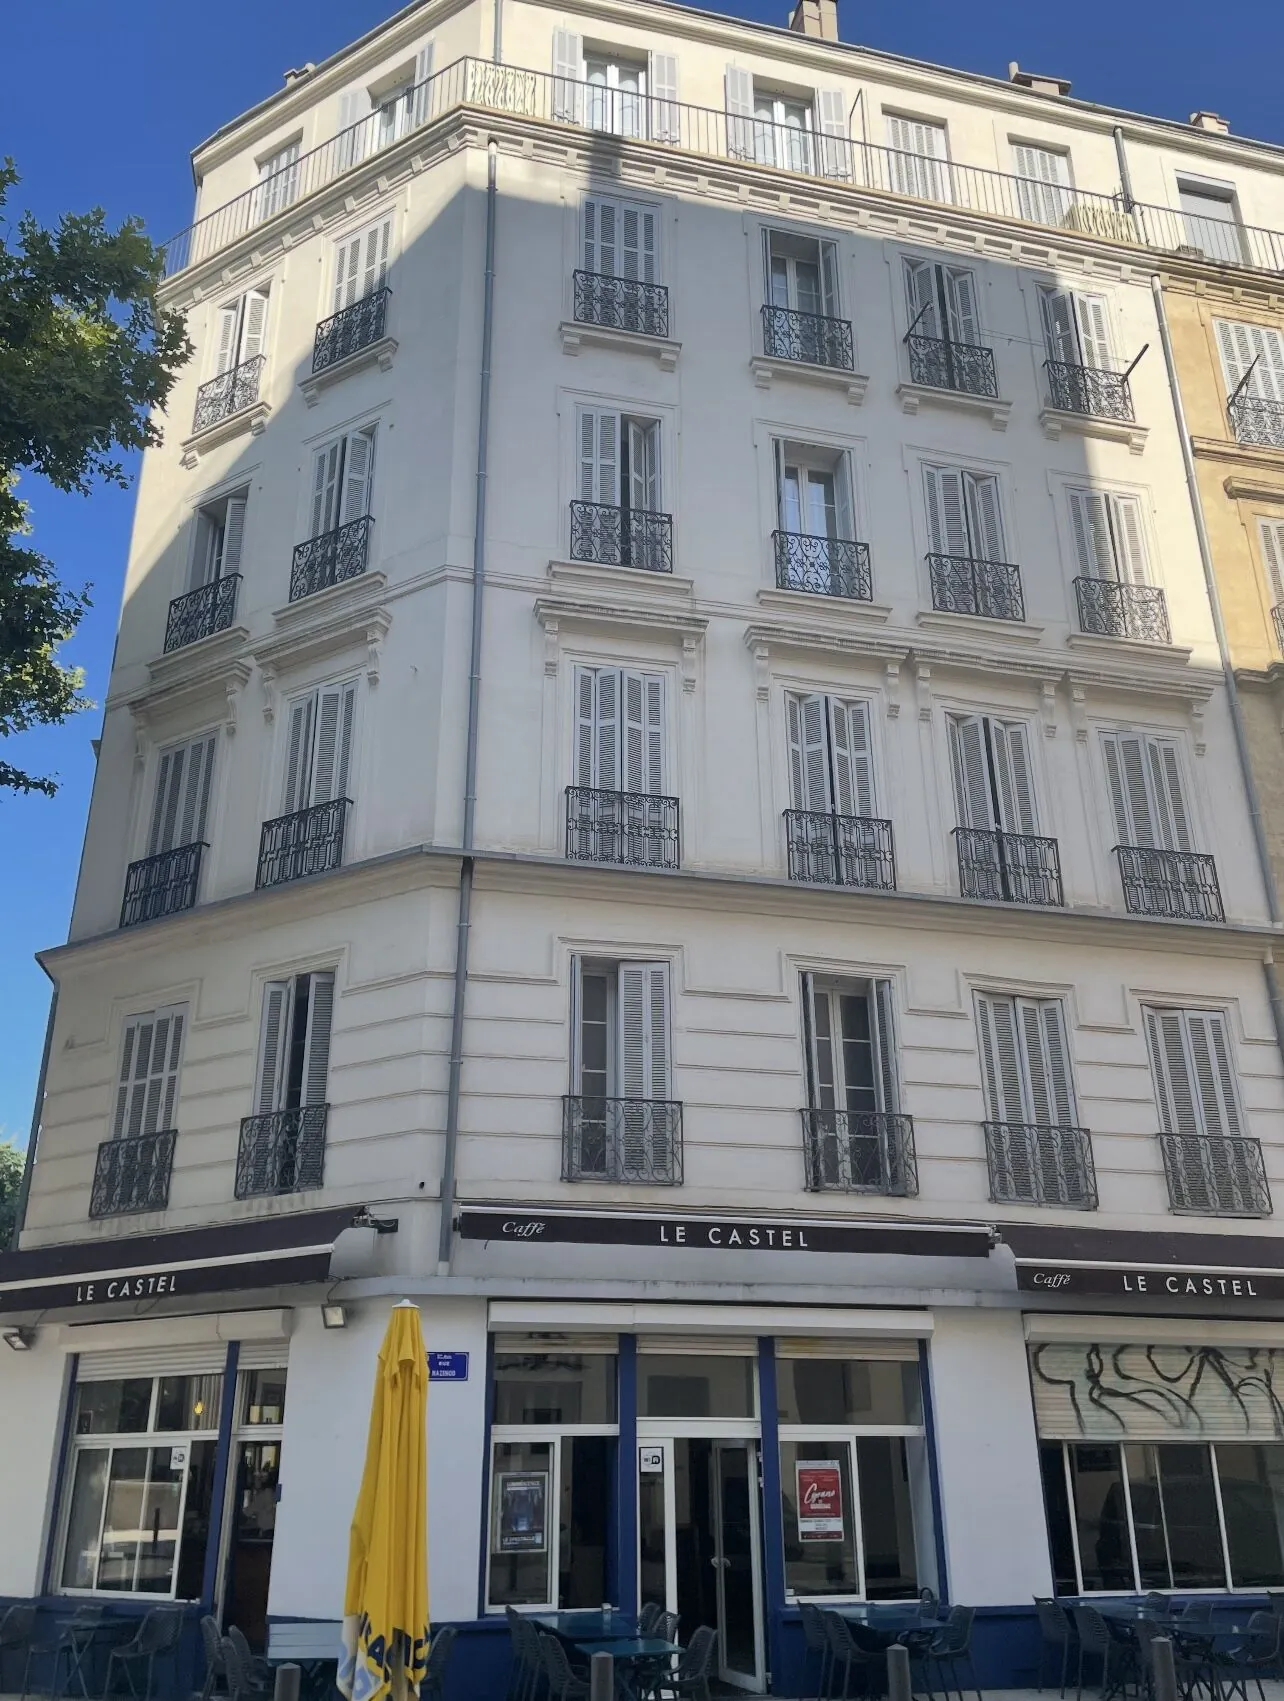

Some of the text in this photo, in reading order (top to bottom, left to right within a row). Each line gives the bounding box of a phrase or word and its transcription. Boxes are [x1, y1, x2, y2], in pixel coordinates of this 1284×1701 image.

[660, 1225, 808, 1247] LE CASTEL
[77, 1276, 176, 1302] LE CASTEL
[1123, 1275, 1257, 1296] LE CASTEL
